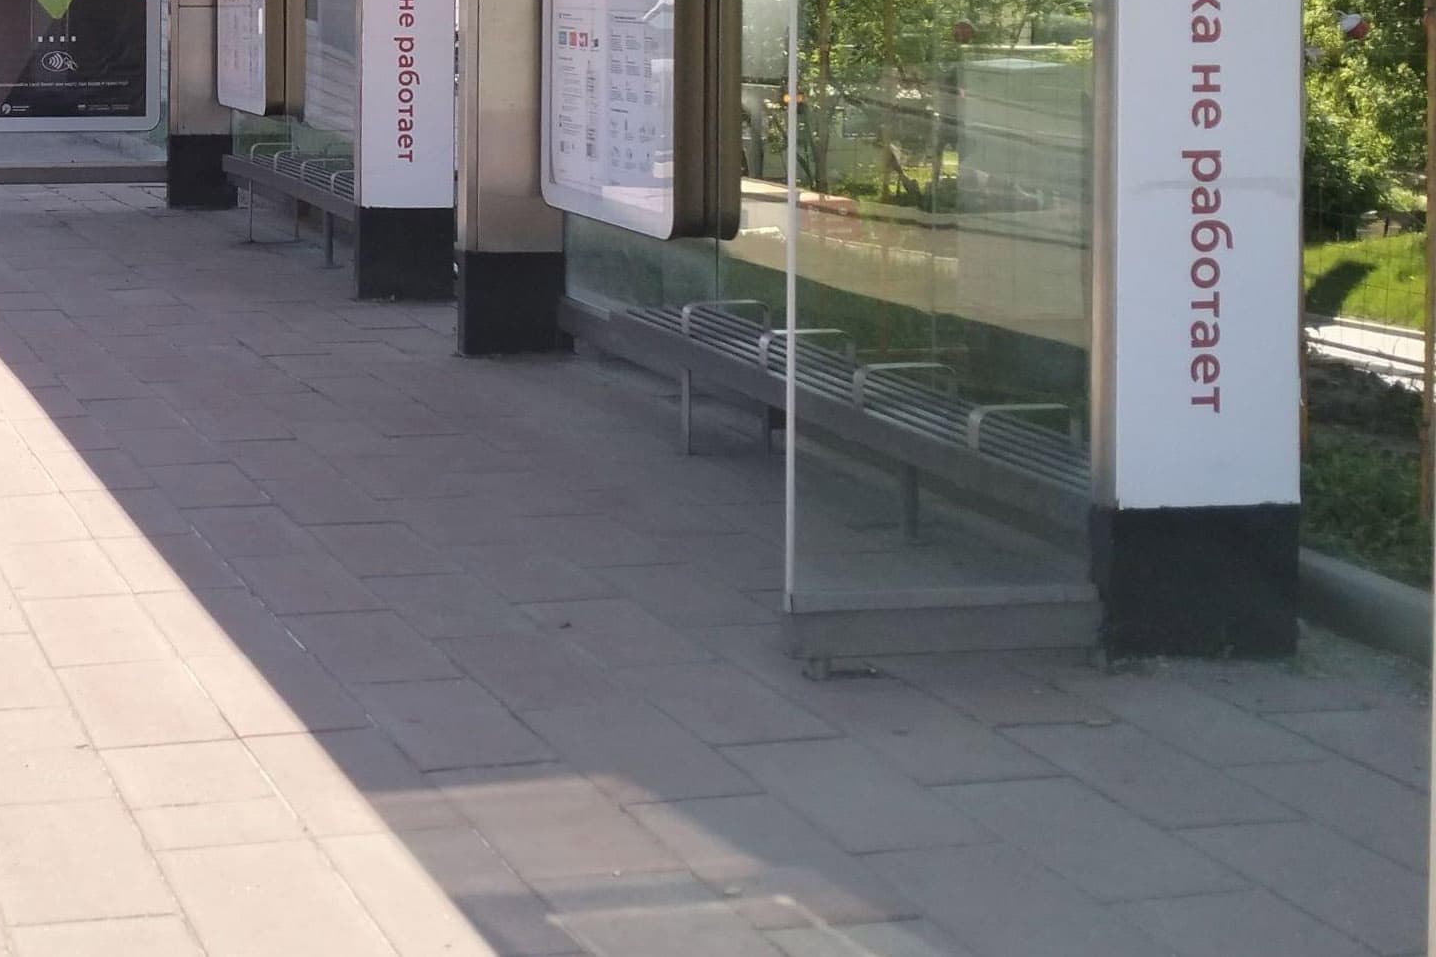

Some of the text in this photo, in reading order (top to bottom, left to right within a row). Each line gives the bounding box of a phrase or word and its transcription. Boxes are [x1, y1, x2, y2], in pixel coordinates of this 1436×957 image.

[393, 35, 421, 163] работает
[1191, 65, 1222, 130] не
[1182, 150, 1234, 413] работает
